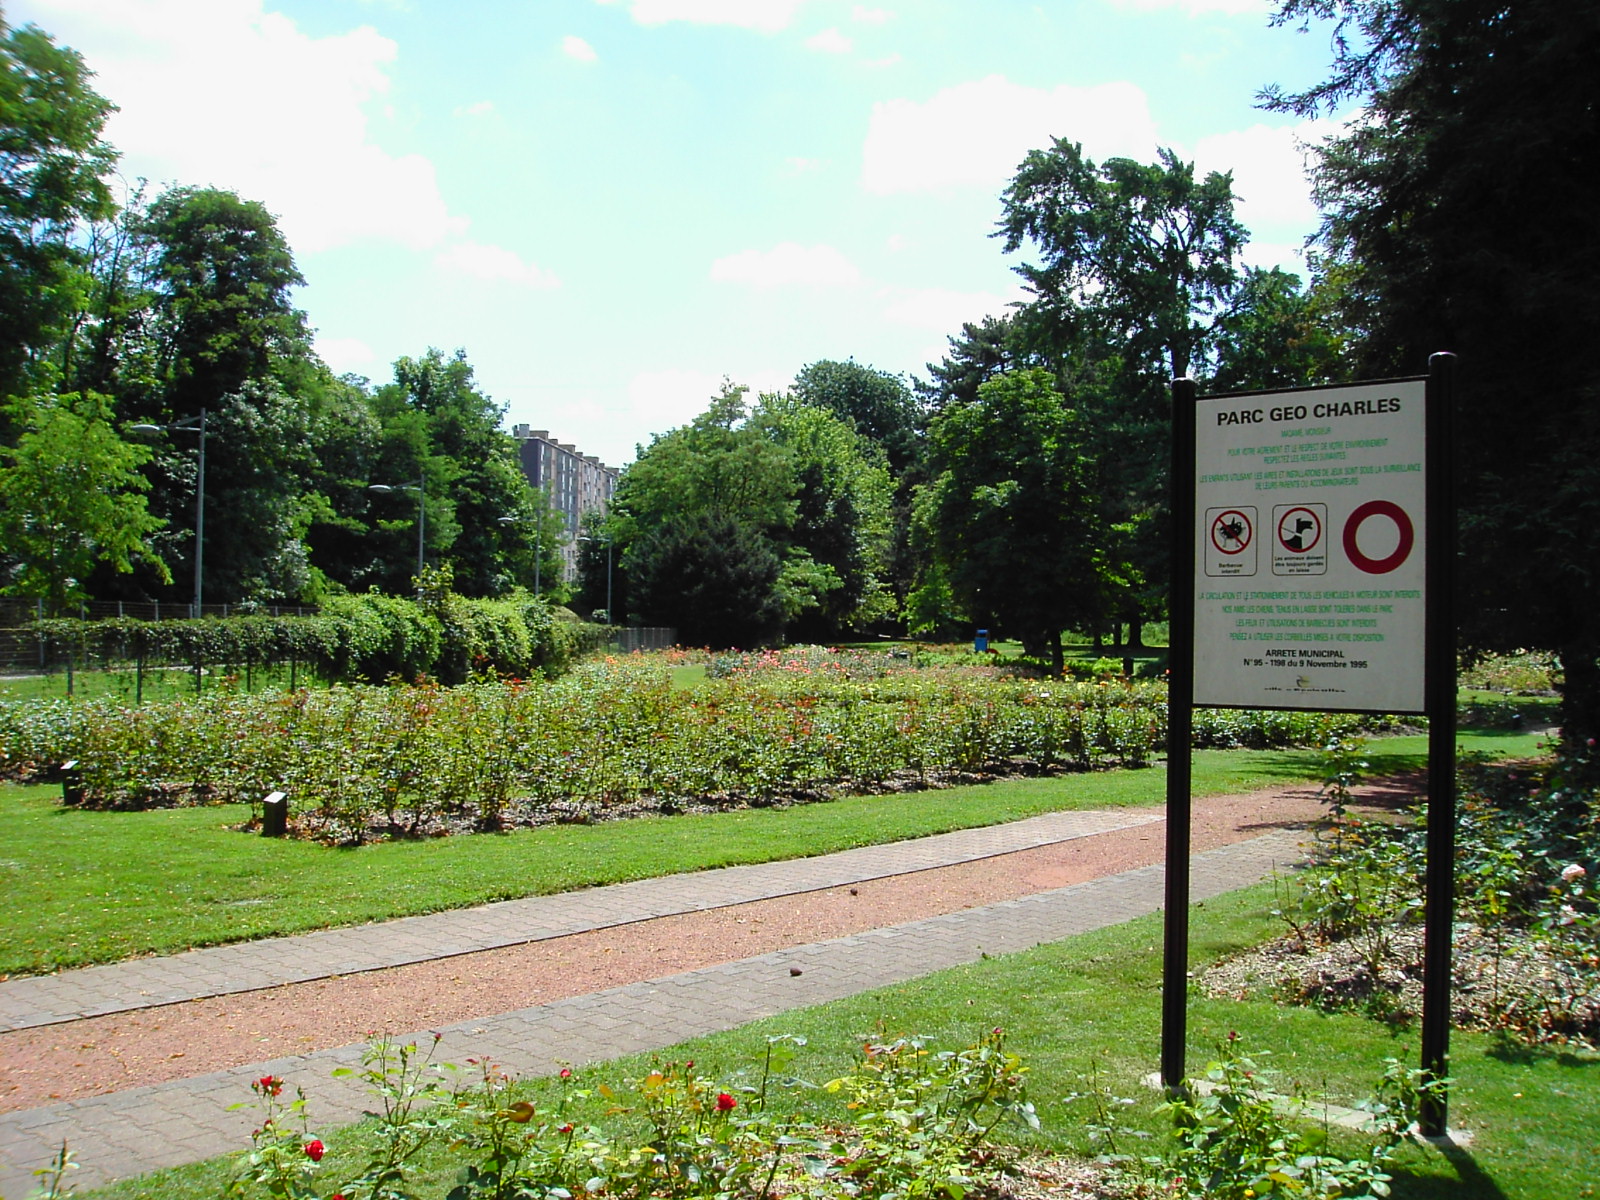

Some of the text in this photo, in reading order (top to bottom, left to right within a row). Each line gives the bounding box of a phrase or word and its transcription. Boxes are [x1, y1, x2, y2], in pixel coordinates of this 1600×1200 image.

[1216, 397, 1401, 426] PARC GEO CHARLES
[1265, 649, 1344, 658] ARRETE MUNICIPAL
[1287, 659, 1298, 667] du
[1299, 659, 1305, 667] 9
[1306, 660, 1347, 668] Novembre
